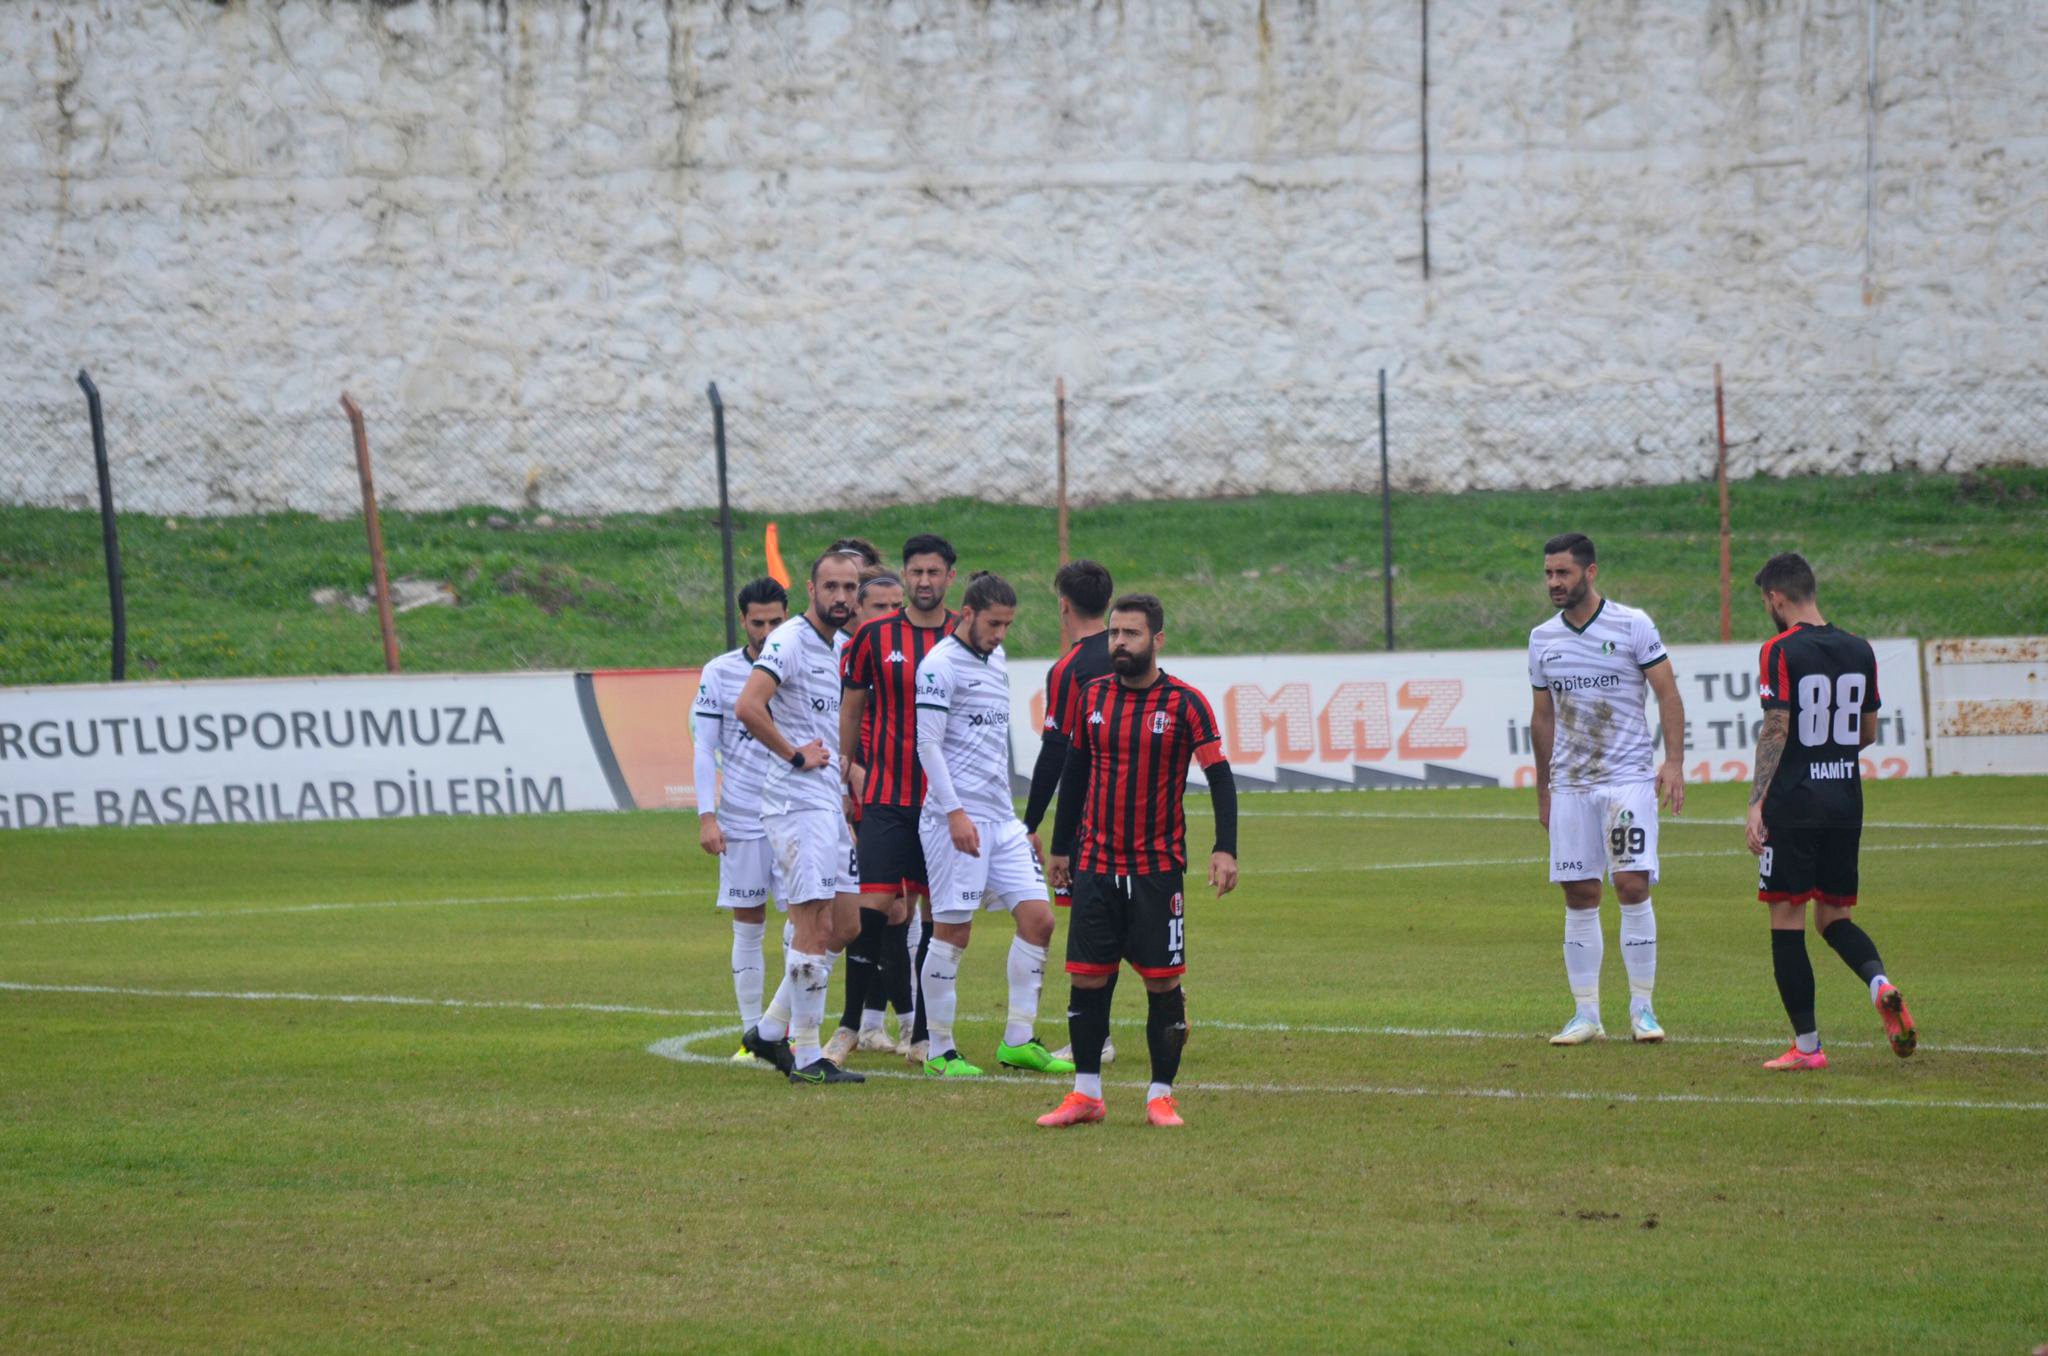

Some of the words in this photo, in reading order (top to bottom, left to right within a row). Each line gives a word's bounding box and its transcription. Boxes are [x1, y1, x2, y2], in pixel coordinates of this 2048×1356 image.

[1564, 673, 1620, 691] bitexen
[1694, 672, 1761, 702] TU
[1799, 673, 1866, 747] 88
[0, 706, 505, 760] RGUTLUSPORUMUZA
[1810, 758, 1855, 779] HAMİT
[94, 780, 361, 826] BASARILAR
[374, 766, 566, 818] DİLERİM
[1611, 827, 1646, 856] 99
[1168, 918, 1184, 952] 15
